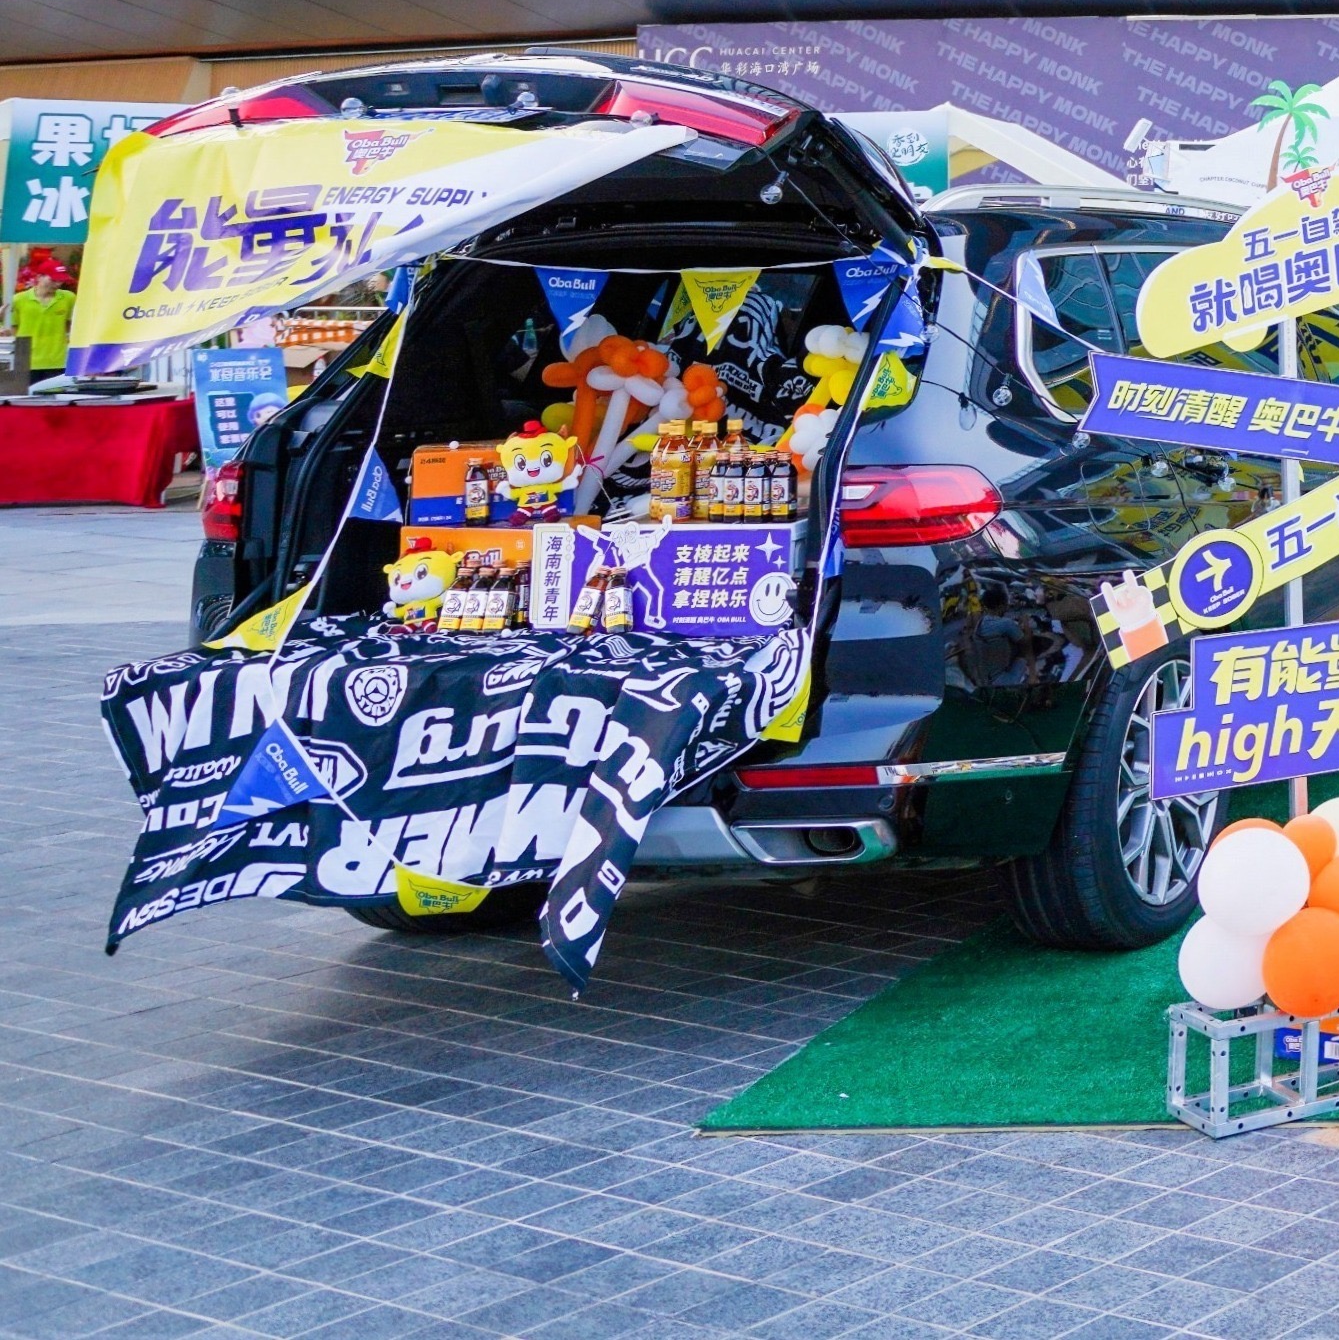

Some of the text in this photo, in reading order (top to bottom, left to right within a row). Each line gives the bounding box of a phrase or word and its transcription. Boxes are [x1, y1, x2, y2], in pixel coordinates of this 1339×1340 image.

[720, 46, 821, 56] HUACAI CENTER
[720, 61, 821, 76] 华彩海口湾广场
[323, 187, 406, 206] ENERGY
[846, 266, 873, 278] Oba
[548, 277, 597, 291] Oba Bull
[122, 305, 156, 321] Oba
[1107, 379, 1249, 429] 时刻清醒
[674, 543, 751, 564] 支棱起来
[542, 535, 563, 622] 海南新青年
[673, 566, 749, 587] 清醒亿点
[672, 589, 748, 610] 拿捏快乐
[265, 741, 310, 795] Oba Bull
